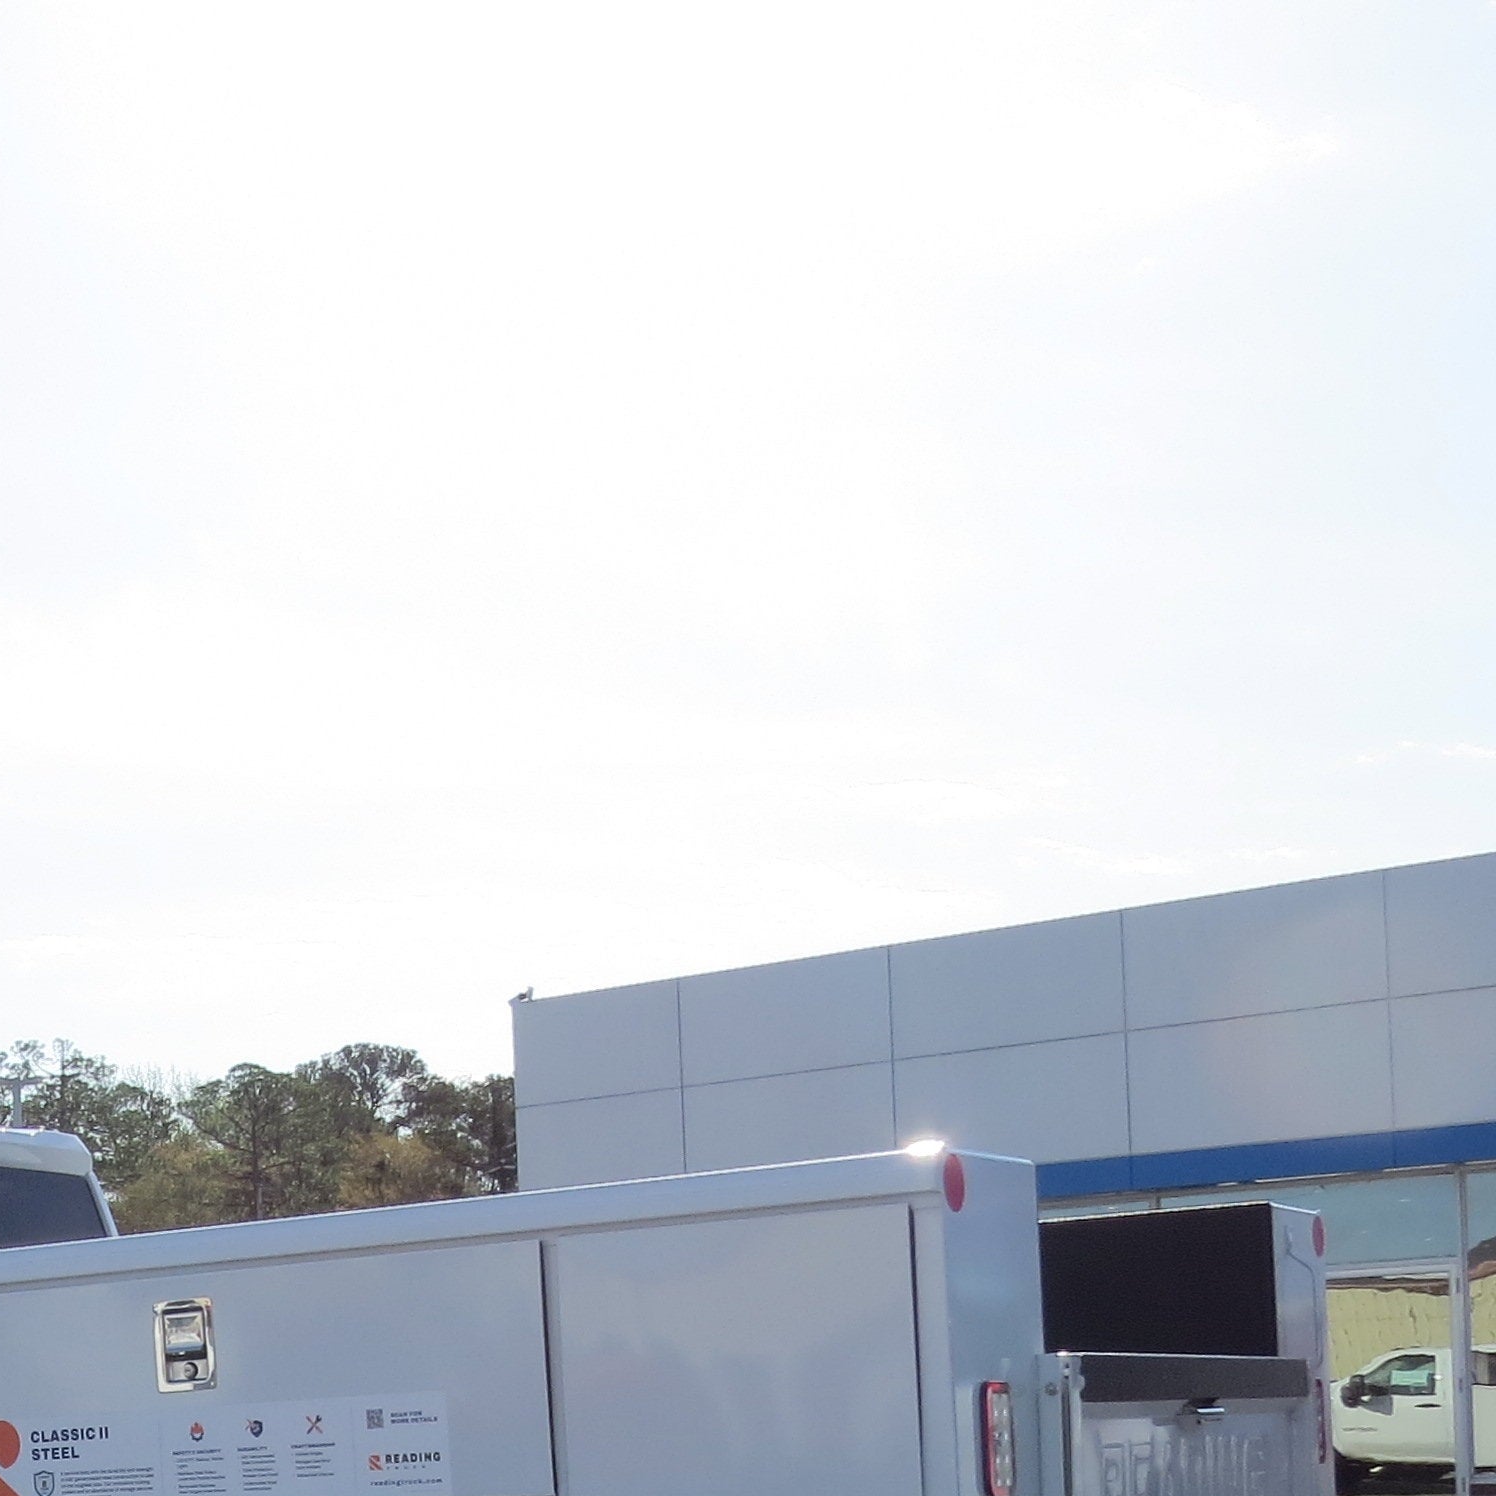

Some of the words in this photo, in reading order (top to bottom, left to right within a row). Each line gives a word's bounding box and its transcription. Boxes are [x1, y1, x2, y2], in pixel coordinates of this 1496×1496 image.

[30, 1428, 96, 1443] CLASSIC
[99, 1427, 109, 1439] II
[31, 1446, 80, 1461] STEEL
[385, 1452, 441, 1464] READING
